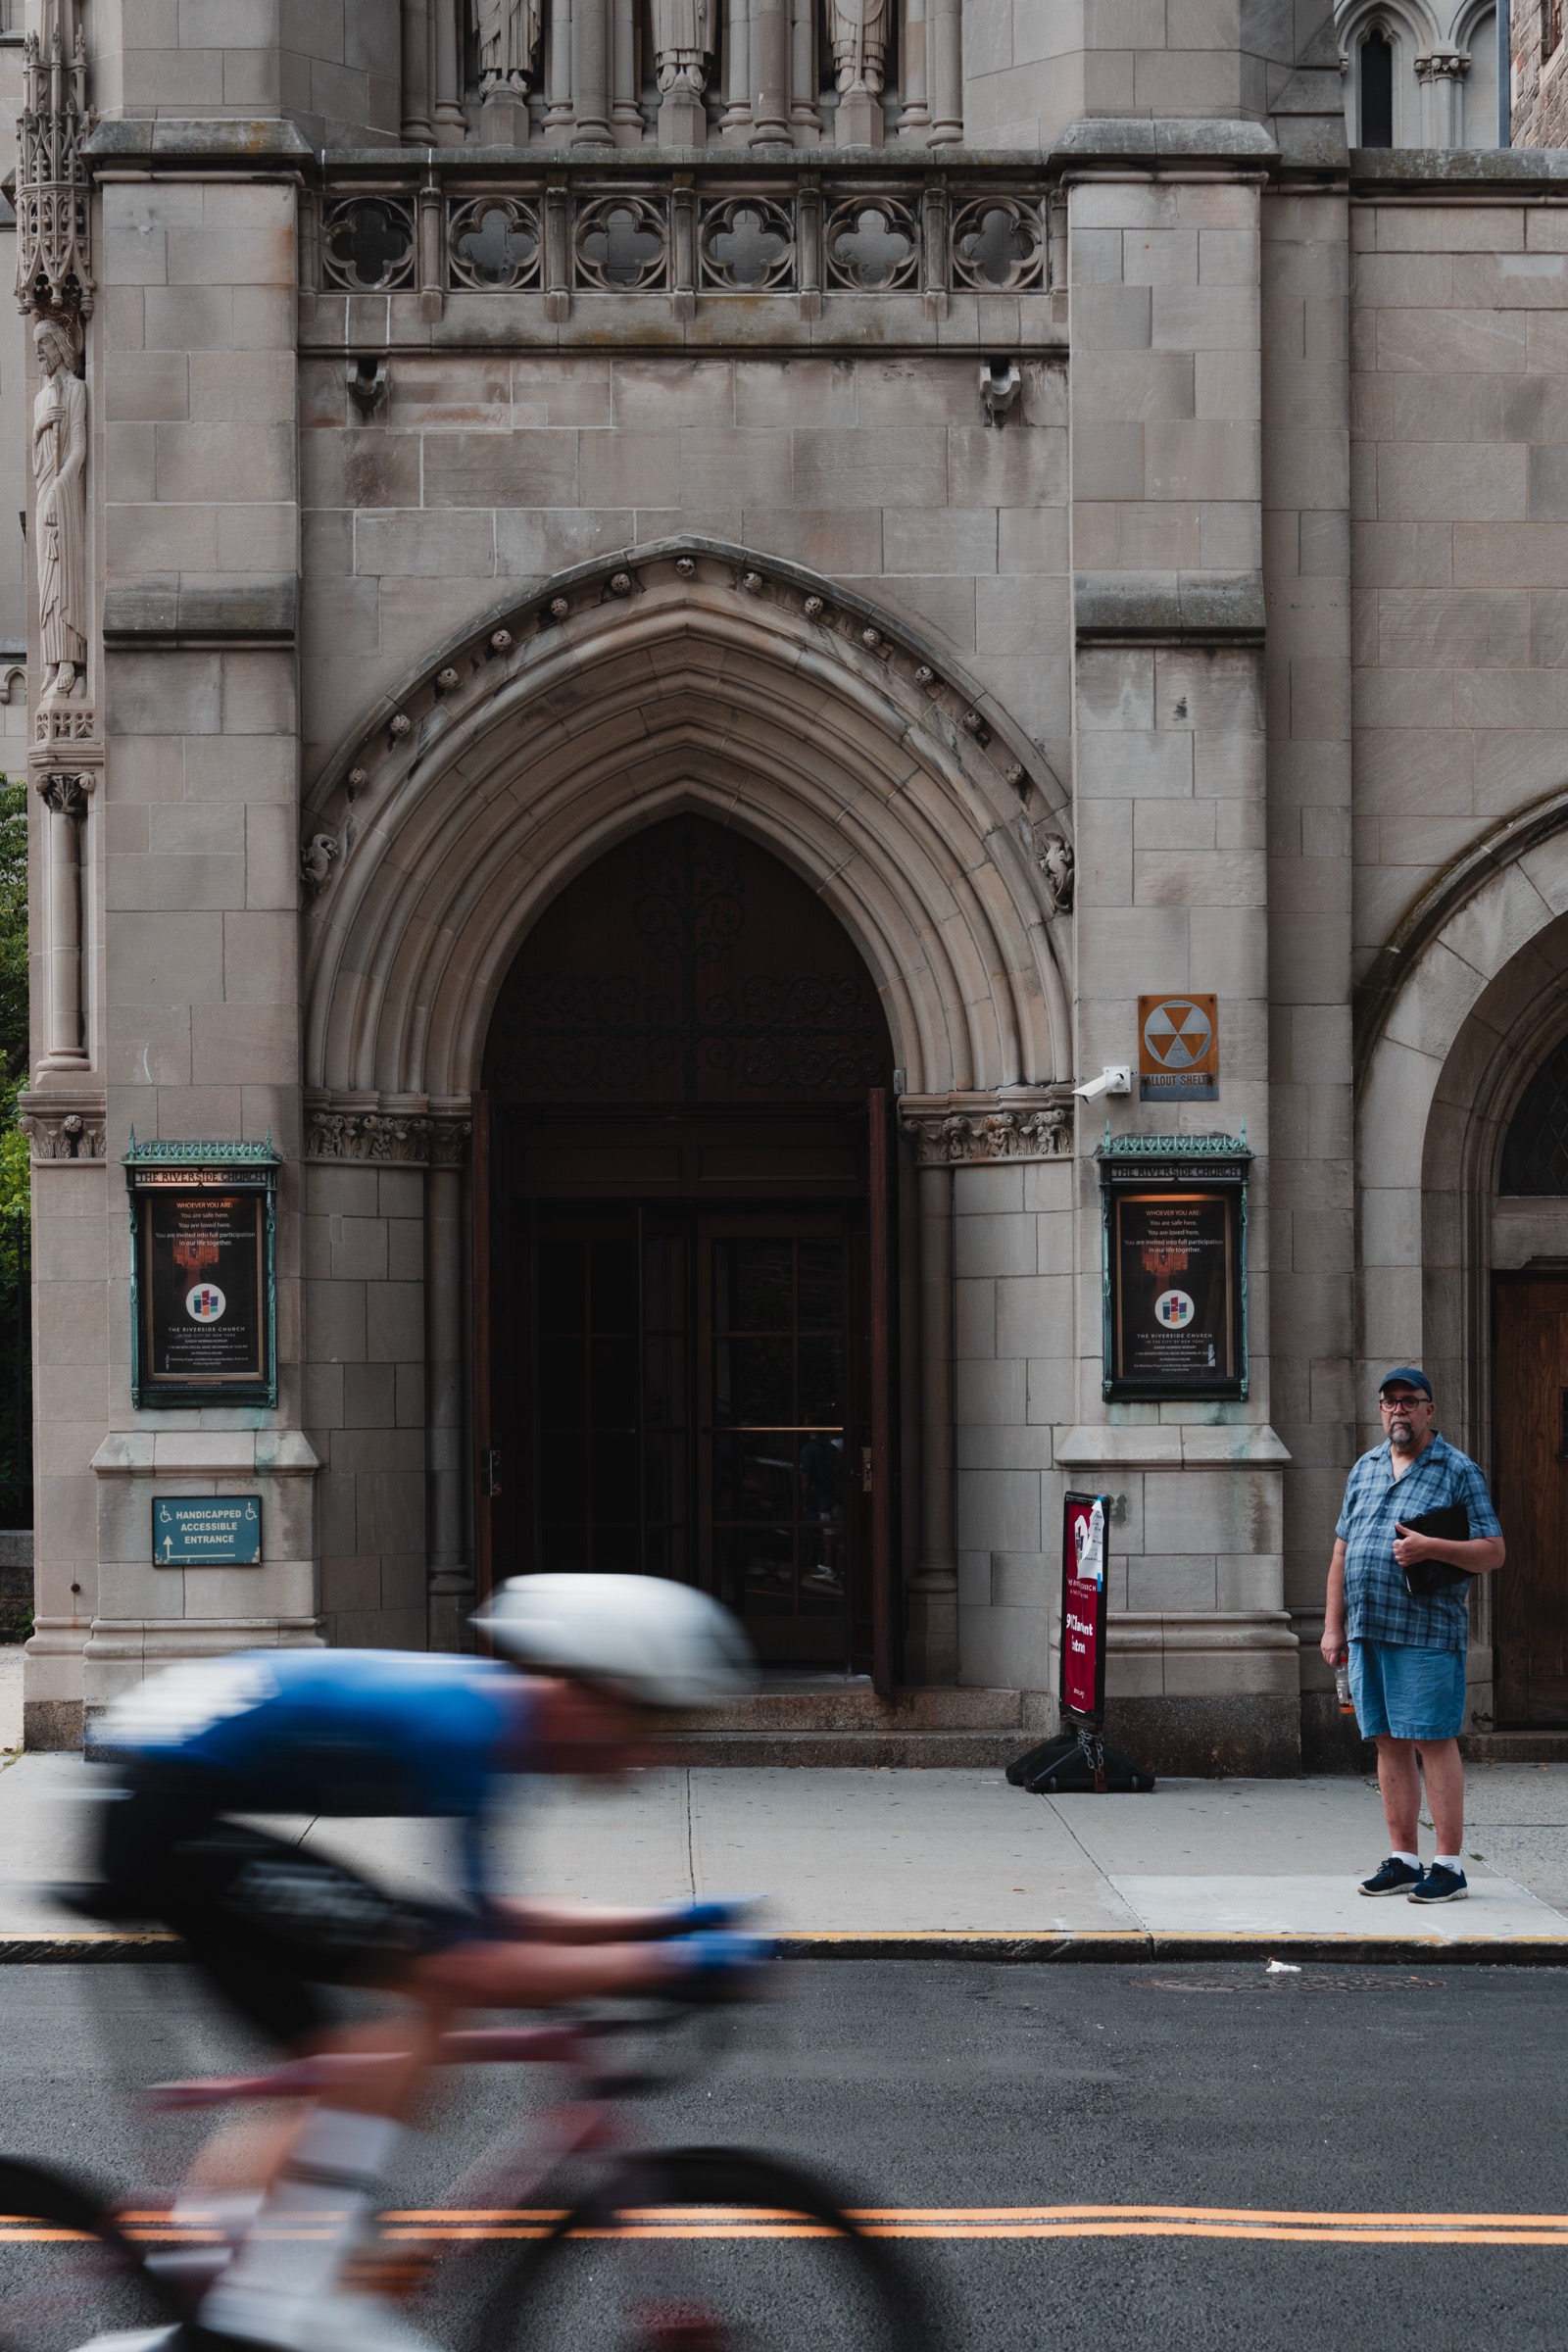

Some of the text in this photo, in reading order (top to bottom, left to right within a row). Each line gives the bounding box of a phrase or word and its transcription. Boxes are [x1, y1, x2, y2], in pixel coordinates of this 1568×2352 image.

[1180, 1075, 1217, 1086] SHELT
[1114, 1167, 1237, 1176] THE RIVERSIDE CHURCH
[139, 1172, 263, 1182] THE RIVERSIDE CHURCH
[176, 1510, 241, 1519] HANDICAPPED
[181, 1522, 237, 1531] ACCESSIBLE
[185, 1535, 234, 1544] ENTRANCE
